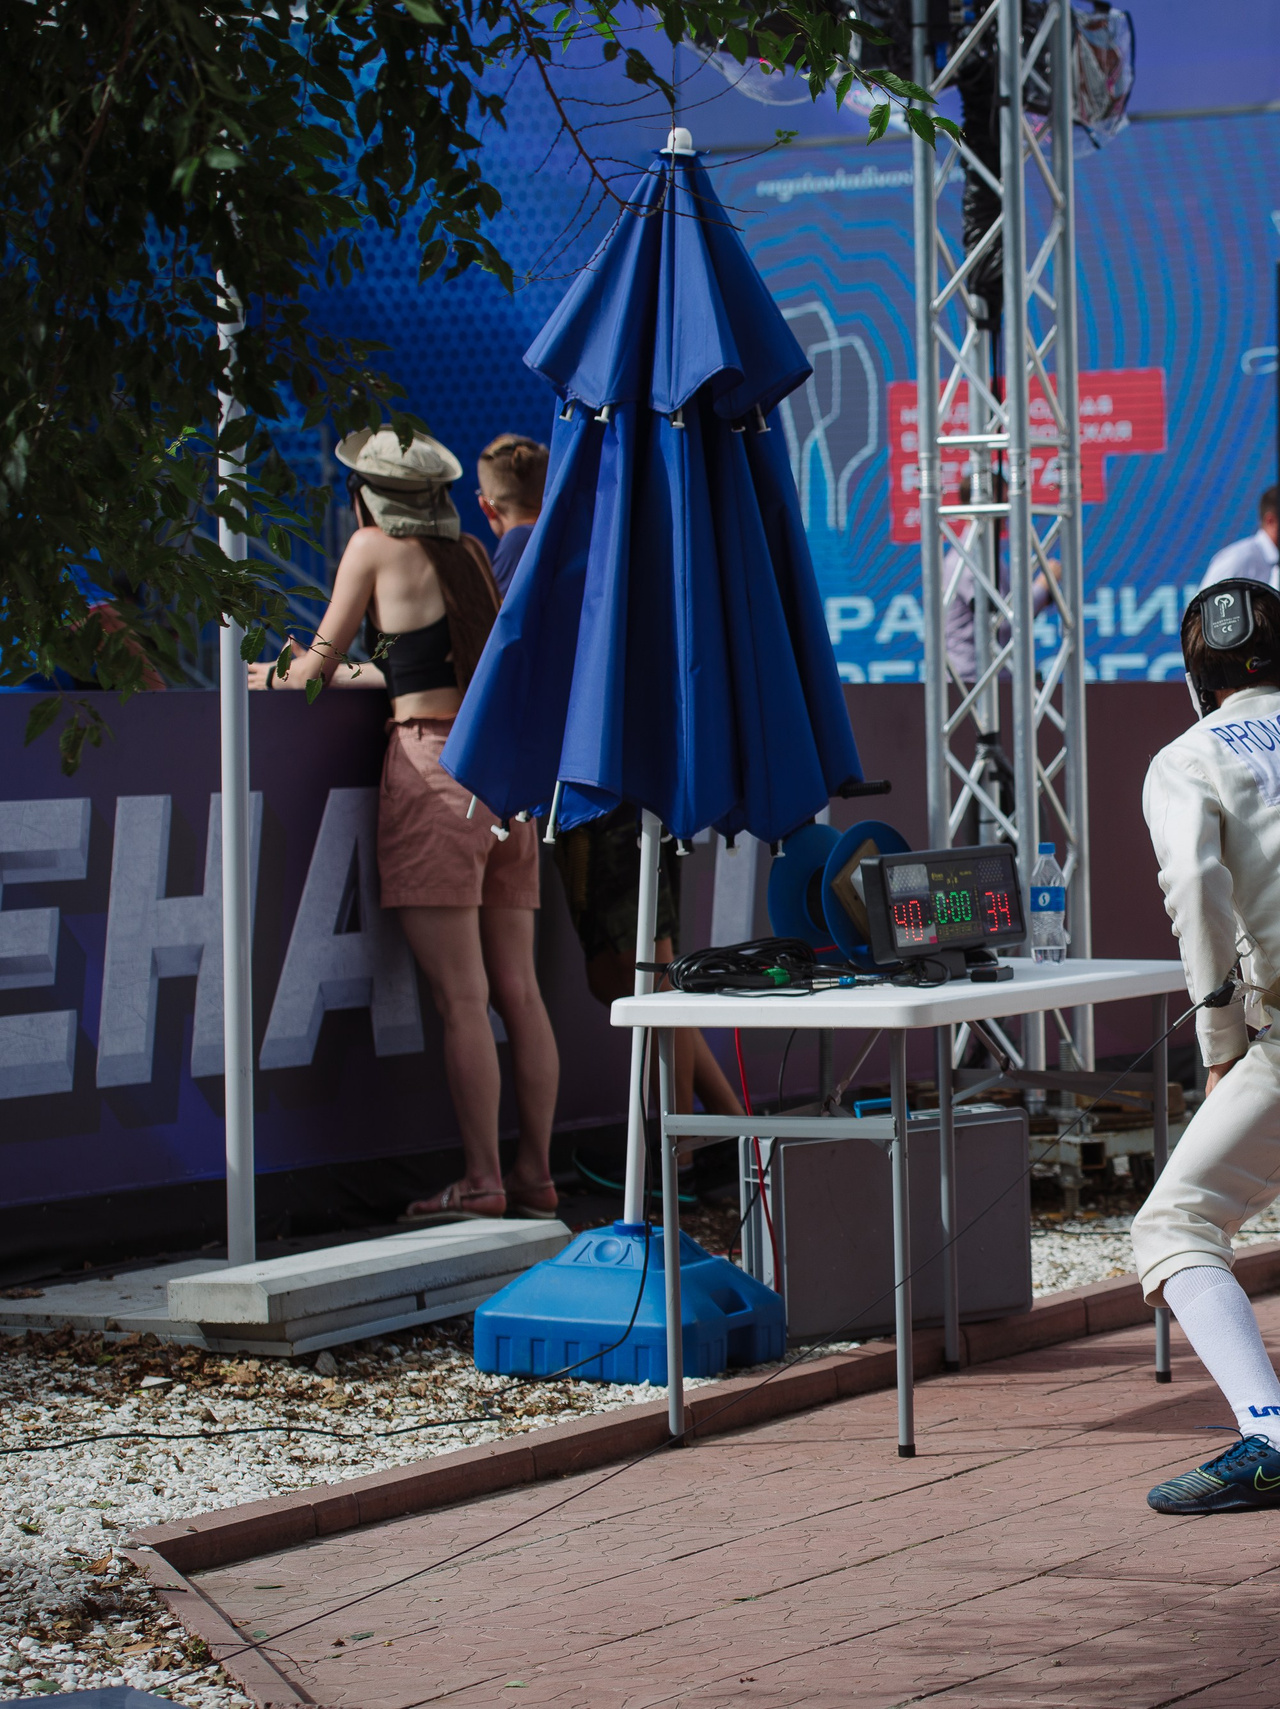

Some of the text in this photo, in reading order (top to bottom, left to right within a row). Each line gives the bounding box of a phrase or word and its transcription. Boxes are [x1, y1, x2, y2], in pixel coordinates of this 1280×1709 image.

[893, 900, 924, 942] 40
[935, 890, 973, 925] 0:00
[984, 891, 1012, 932] 34
